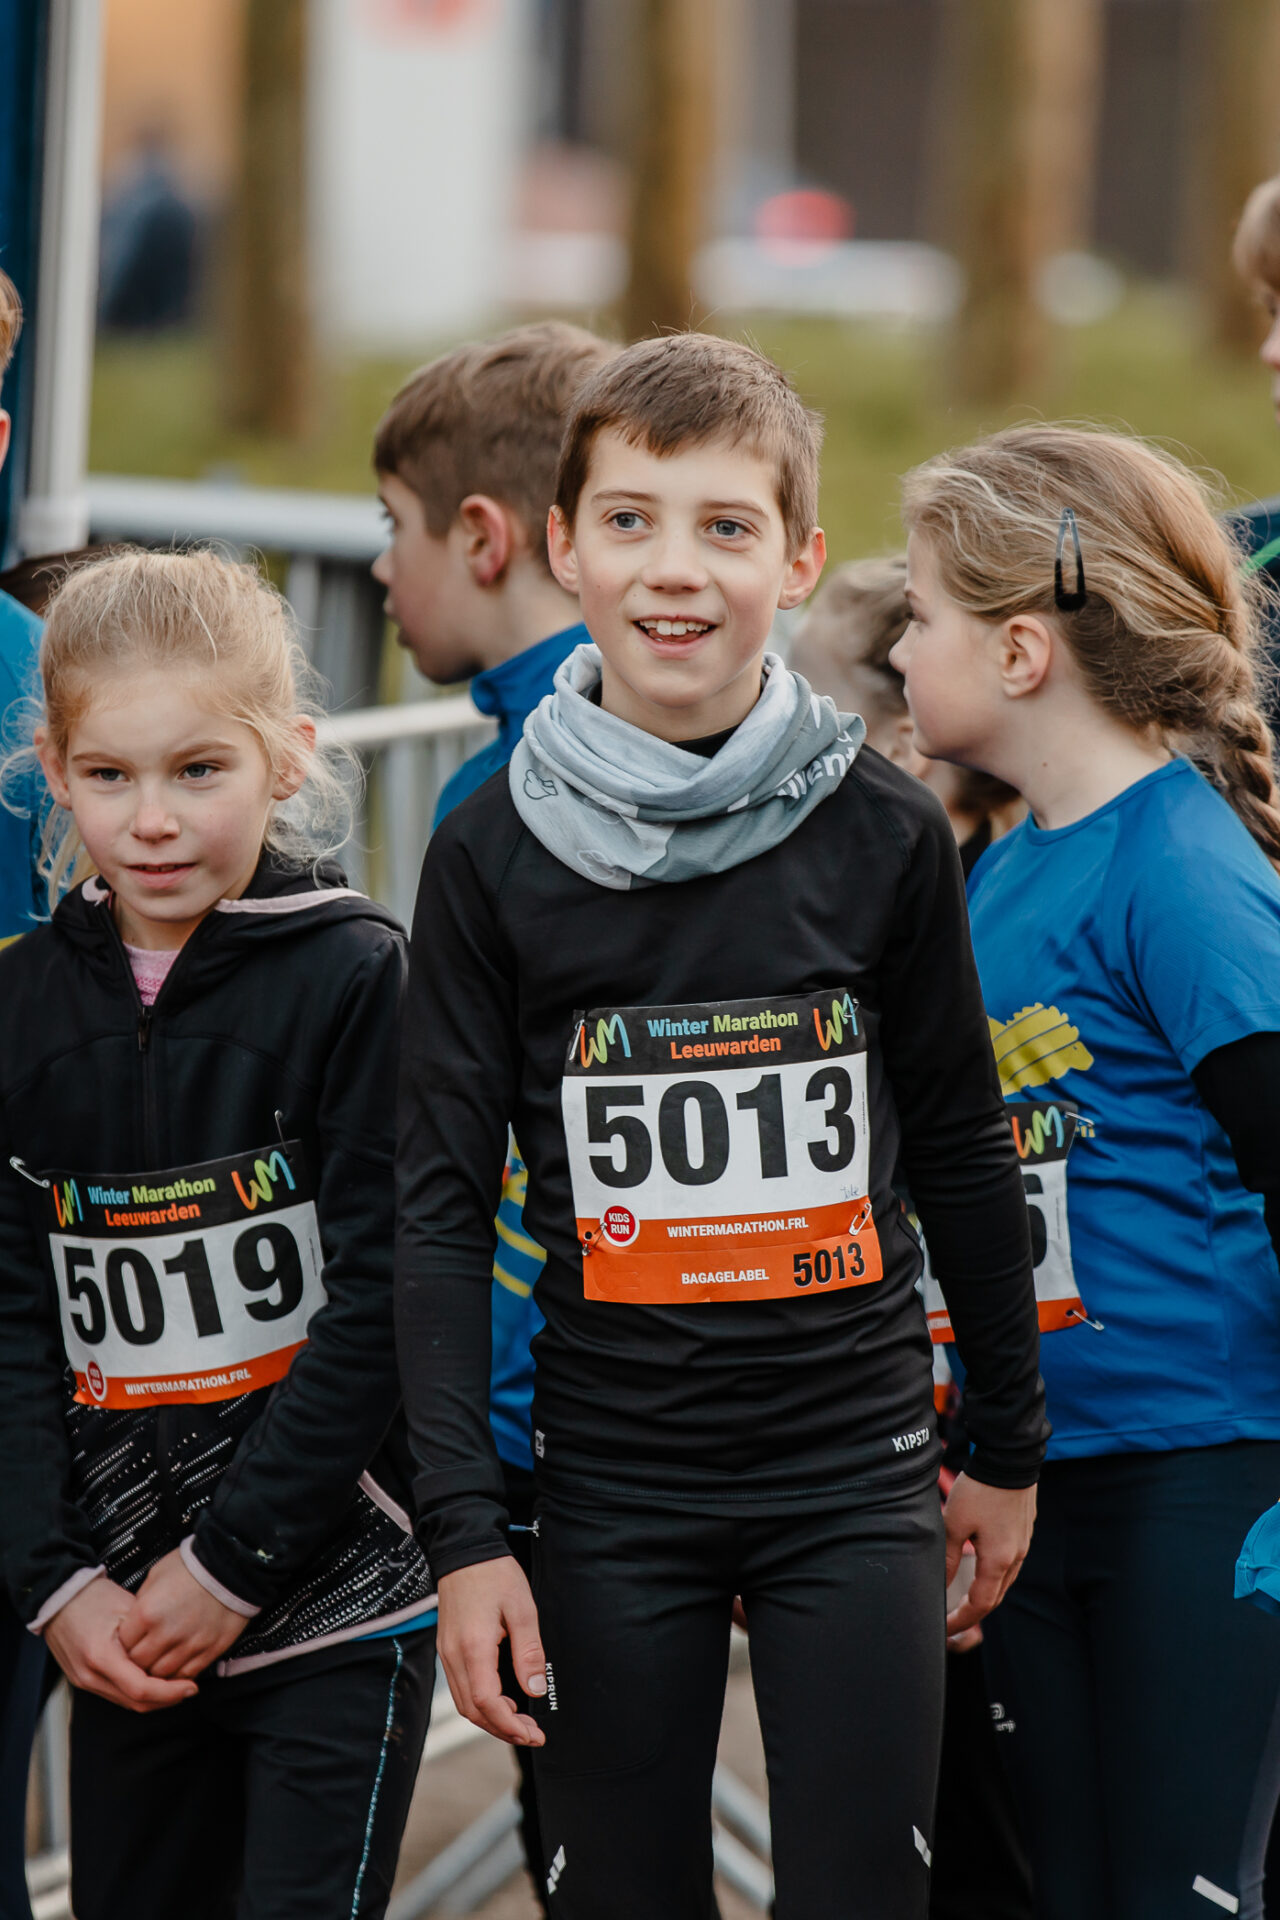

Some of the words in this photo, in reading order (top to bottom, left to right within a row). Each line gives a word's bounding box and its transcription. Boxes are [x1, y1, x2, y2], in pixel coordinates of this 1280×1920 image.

[647, 1019, 709, 1038] Winter
[713, 1010, 799, 1033] Marathon
[670, 1035, 782, 1060] Leeuwarden
[585, 1066, 856, 1189] 5013
[87, 1185, 130, 1205] Winter
[132, 1177, 217, 1204] Marathon
[105, 1203, 201, 1227] Leeuwarden
[608, 1212, 630, 1224] KIDS
[666, 1216, 809, 1238] WINTERMARATHON.FRL
[611, 1223, 630, 1235] RUN
[681, 1268, 770, 1285] BAGAGELABEL
[793, 1241, 866, 1288] 5013
[63, 1222, 304, 1346] 5019
[124, 1367, 252, 1396] WINTERMARATHON.FRL
[892, 1427, 930, 1452] KIPSTA
[545, 1662, 559, 1711] KIPRUN
